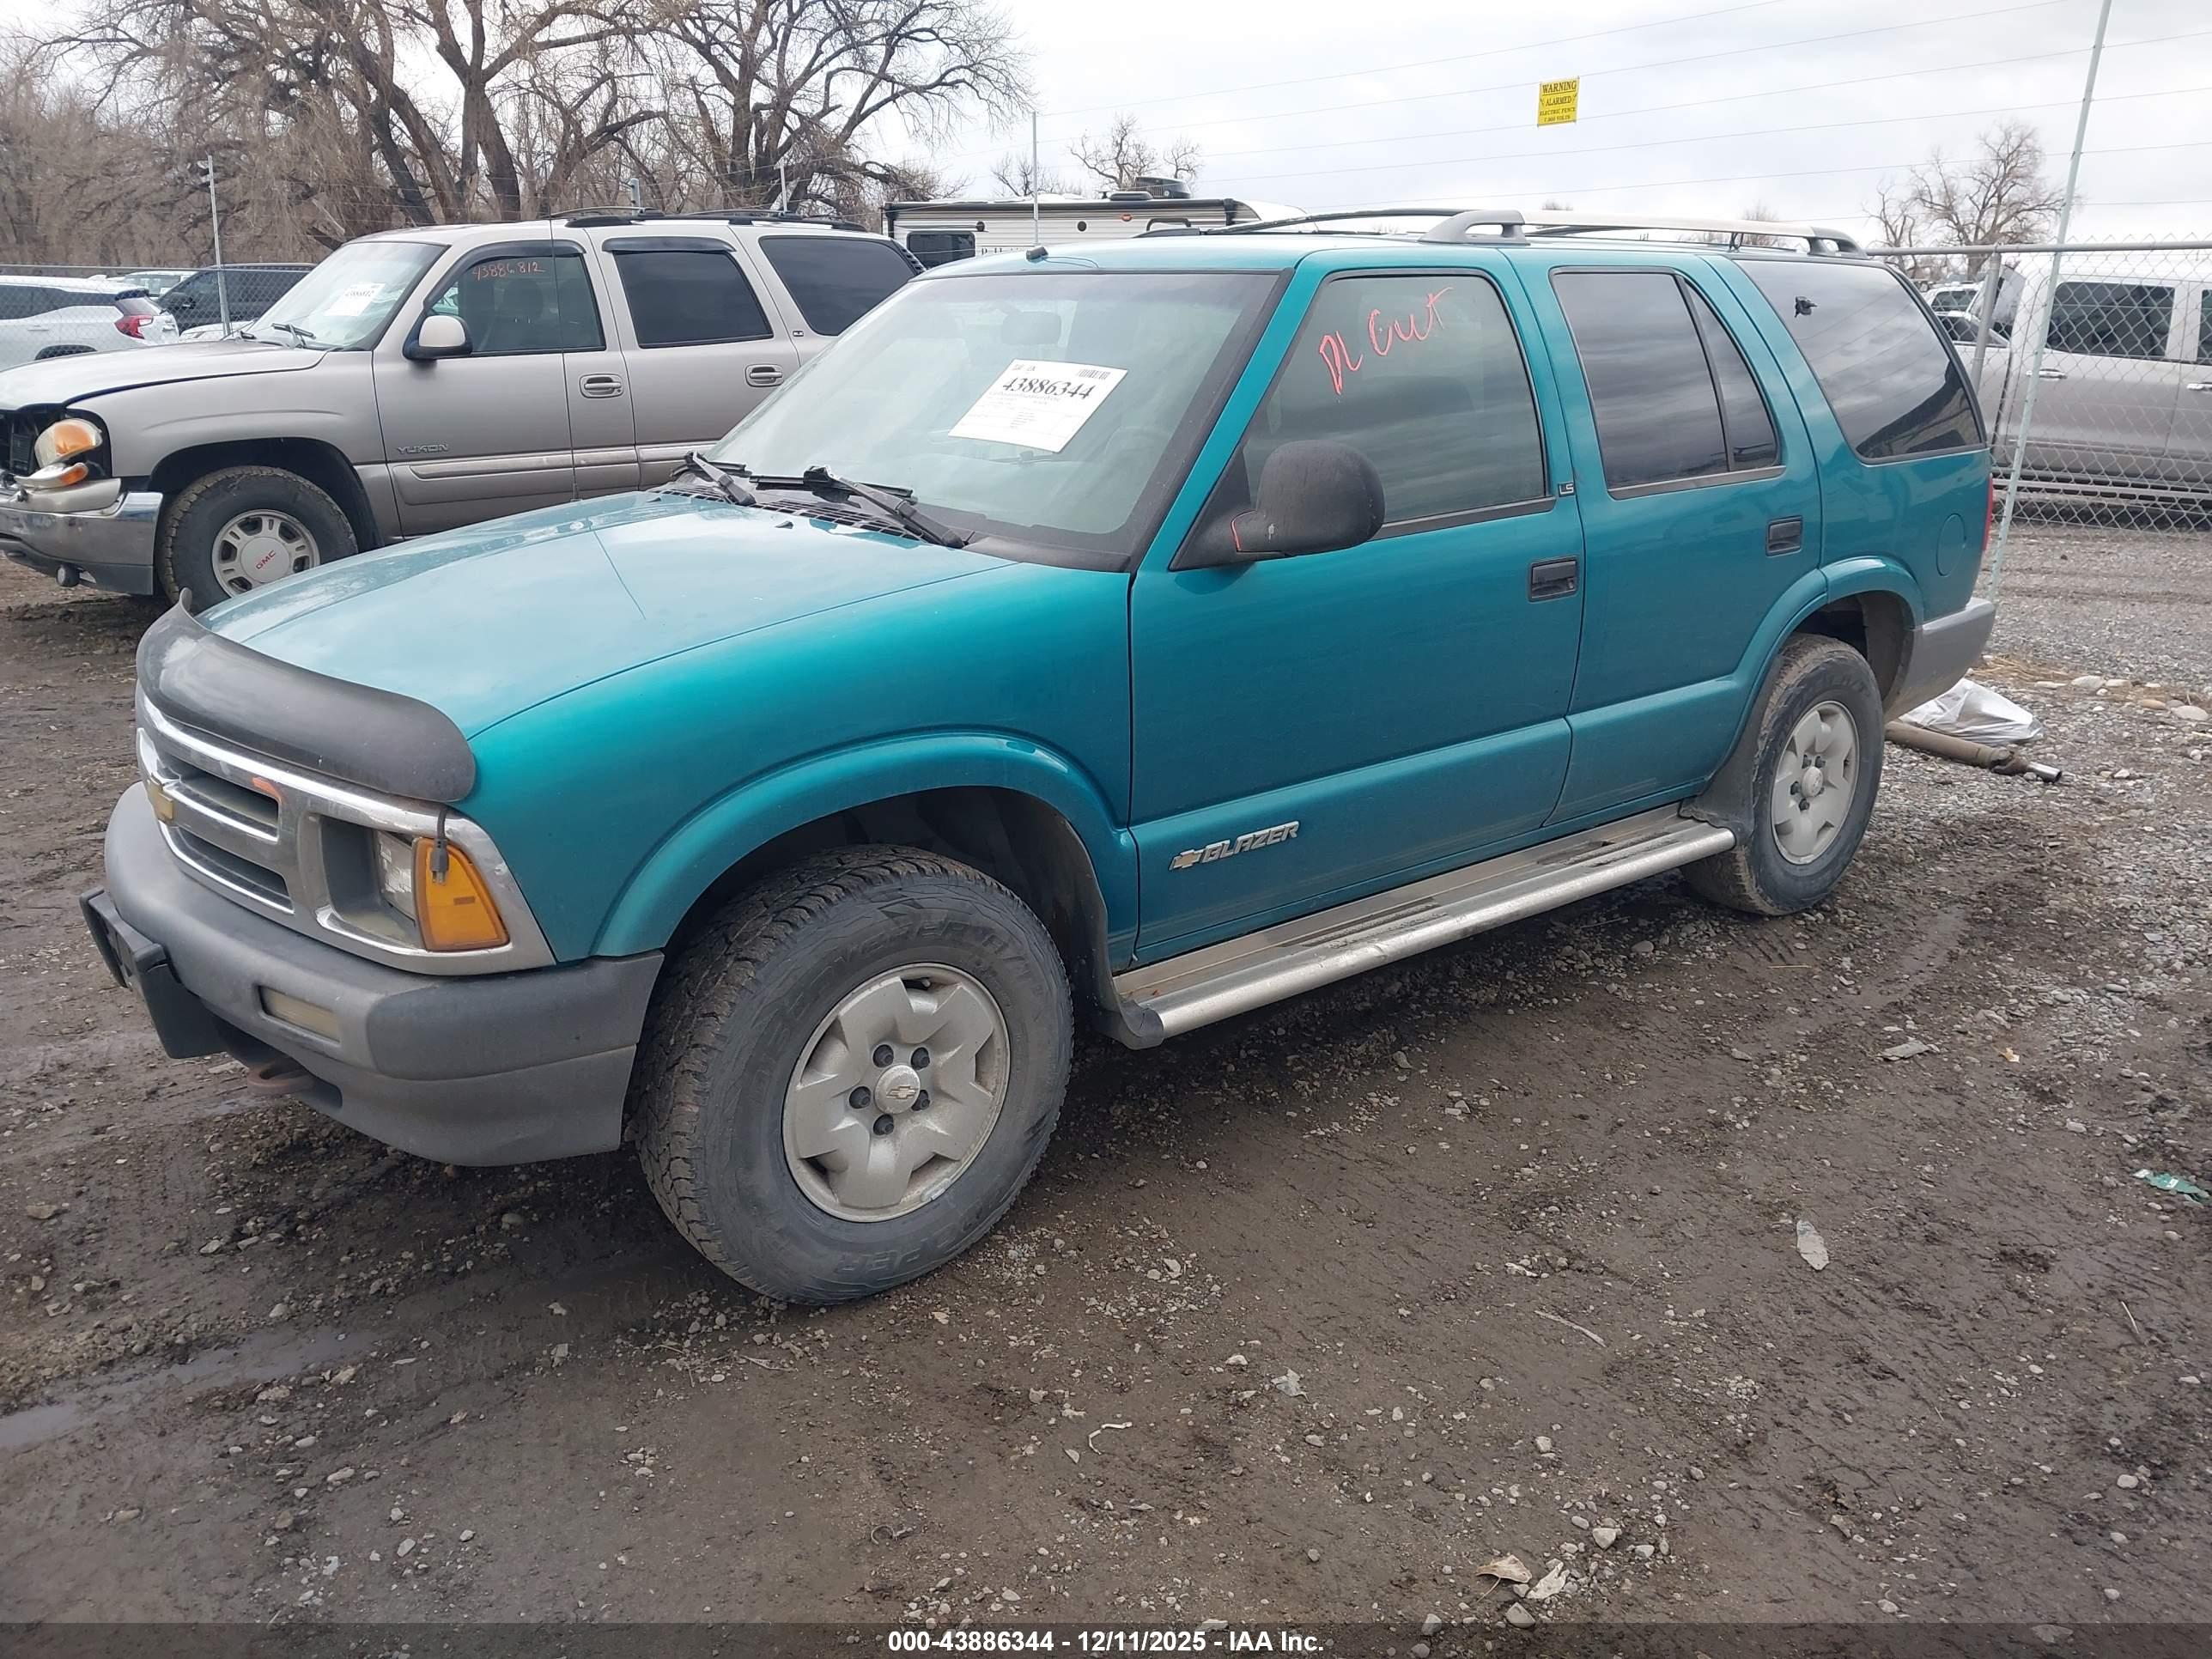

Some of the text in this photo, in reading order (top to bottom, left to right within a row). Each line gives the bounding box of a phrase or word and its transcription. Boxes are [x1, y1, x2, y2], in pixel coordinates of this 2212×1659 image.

[1542, 80, 1577, 94] WARNING
[1546, 95, 1572, 106] ALARMED
[1003, 377, 1096, 400] 43886344
[398, 443, 449, 454] YUKON
[1559, 483, 1574, 495] LS
[255, 550, 276, 570] GMC
[1200, 820, 1300, 864] BLAZER
